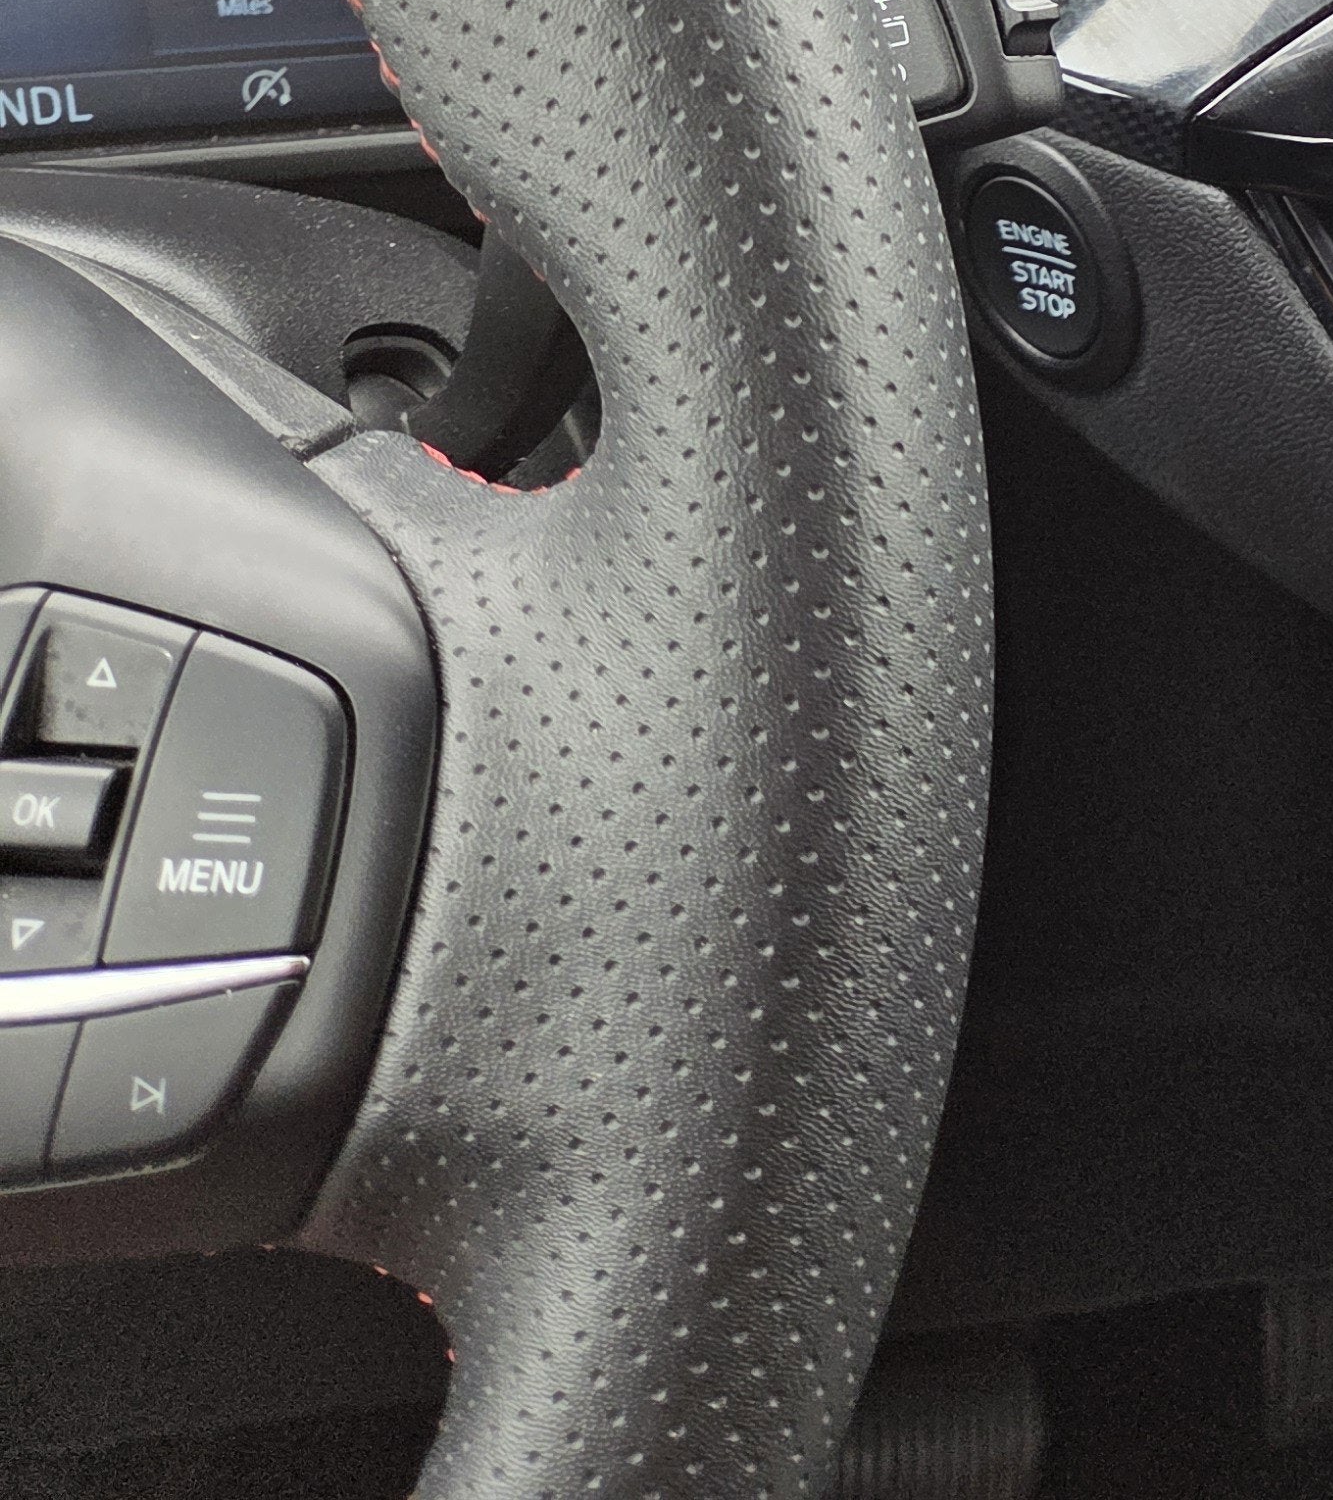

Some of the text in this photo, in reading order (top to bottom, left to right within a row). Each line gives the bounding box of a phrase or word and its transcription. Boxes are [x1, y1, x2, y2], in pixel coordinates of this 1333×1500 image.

[996, 219, 1072, 256] ENGINE
[1010, 260, 1075, 296] START
[1020, 287, 1076, 320] STOP
[11, 793, 58, 828] OK
[157, 856, 265, 896] MENU
